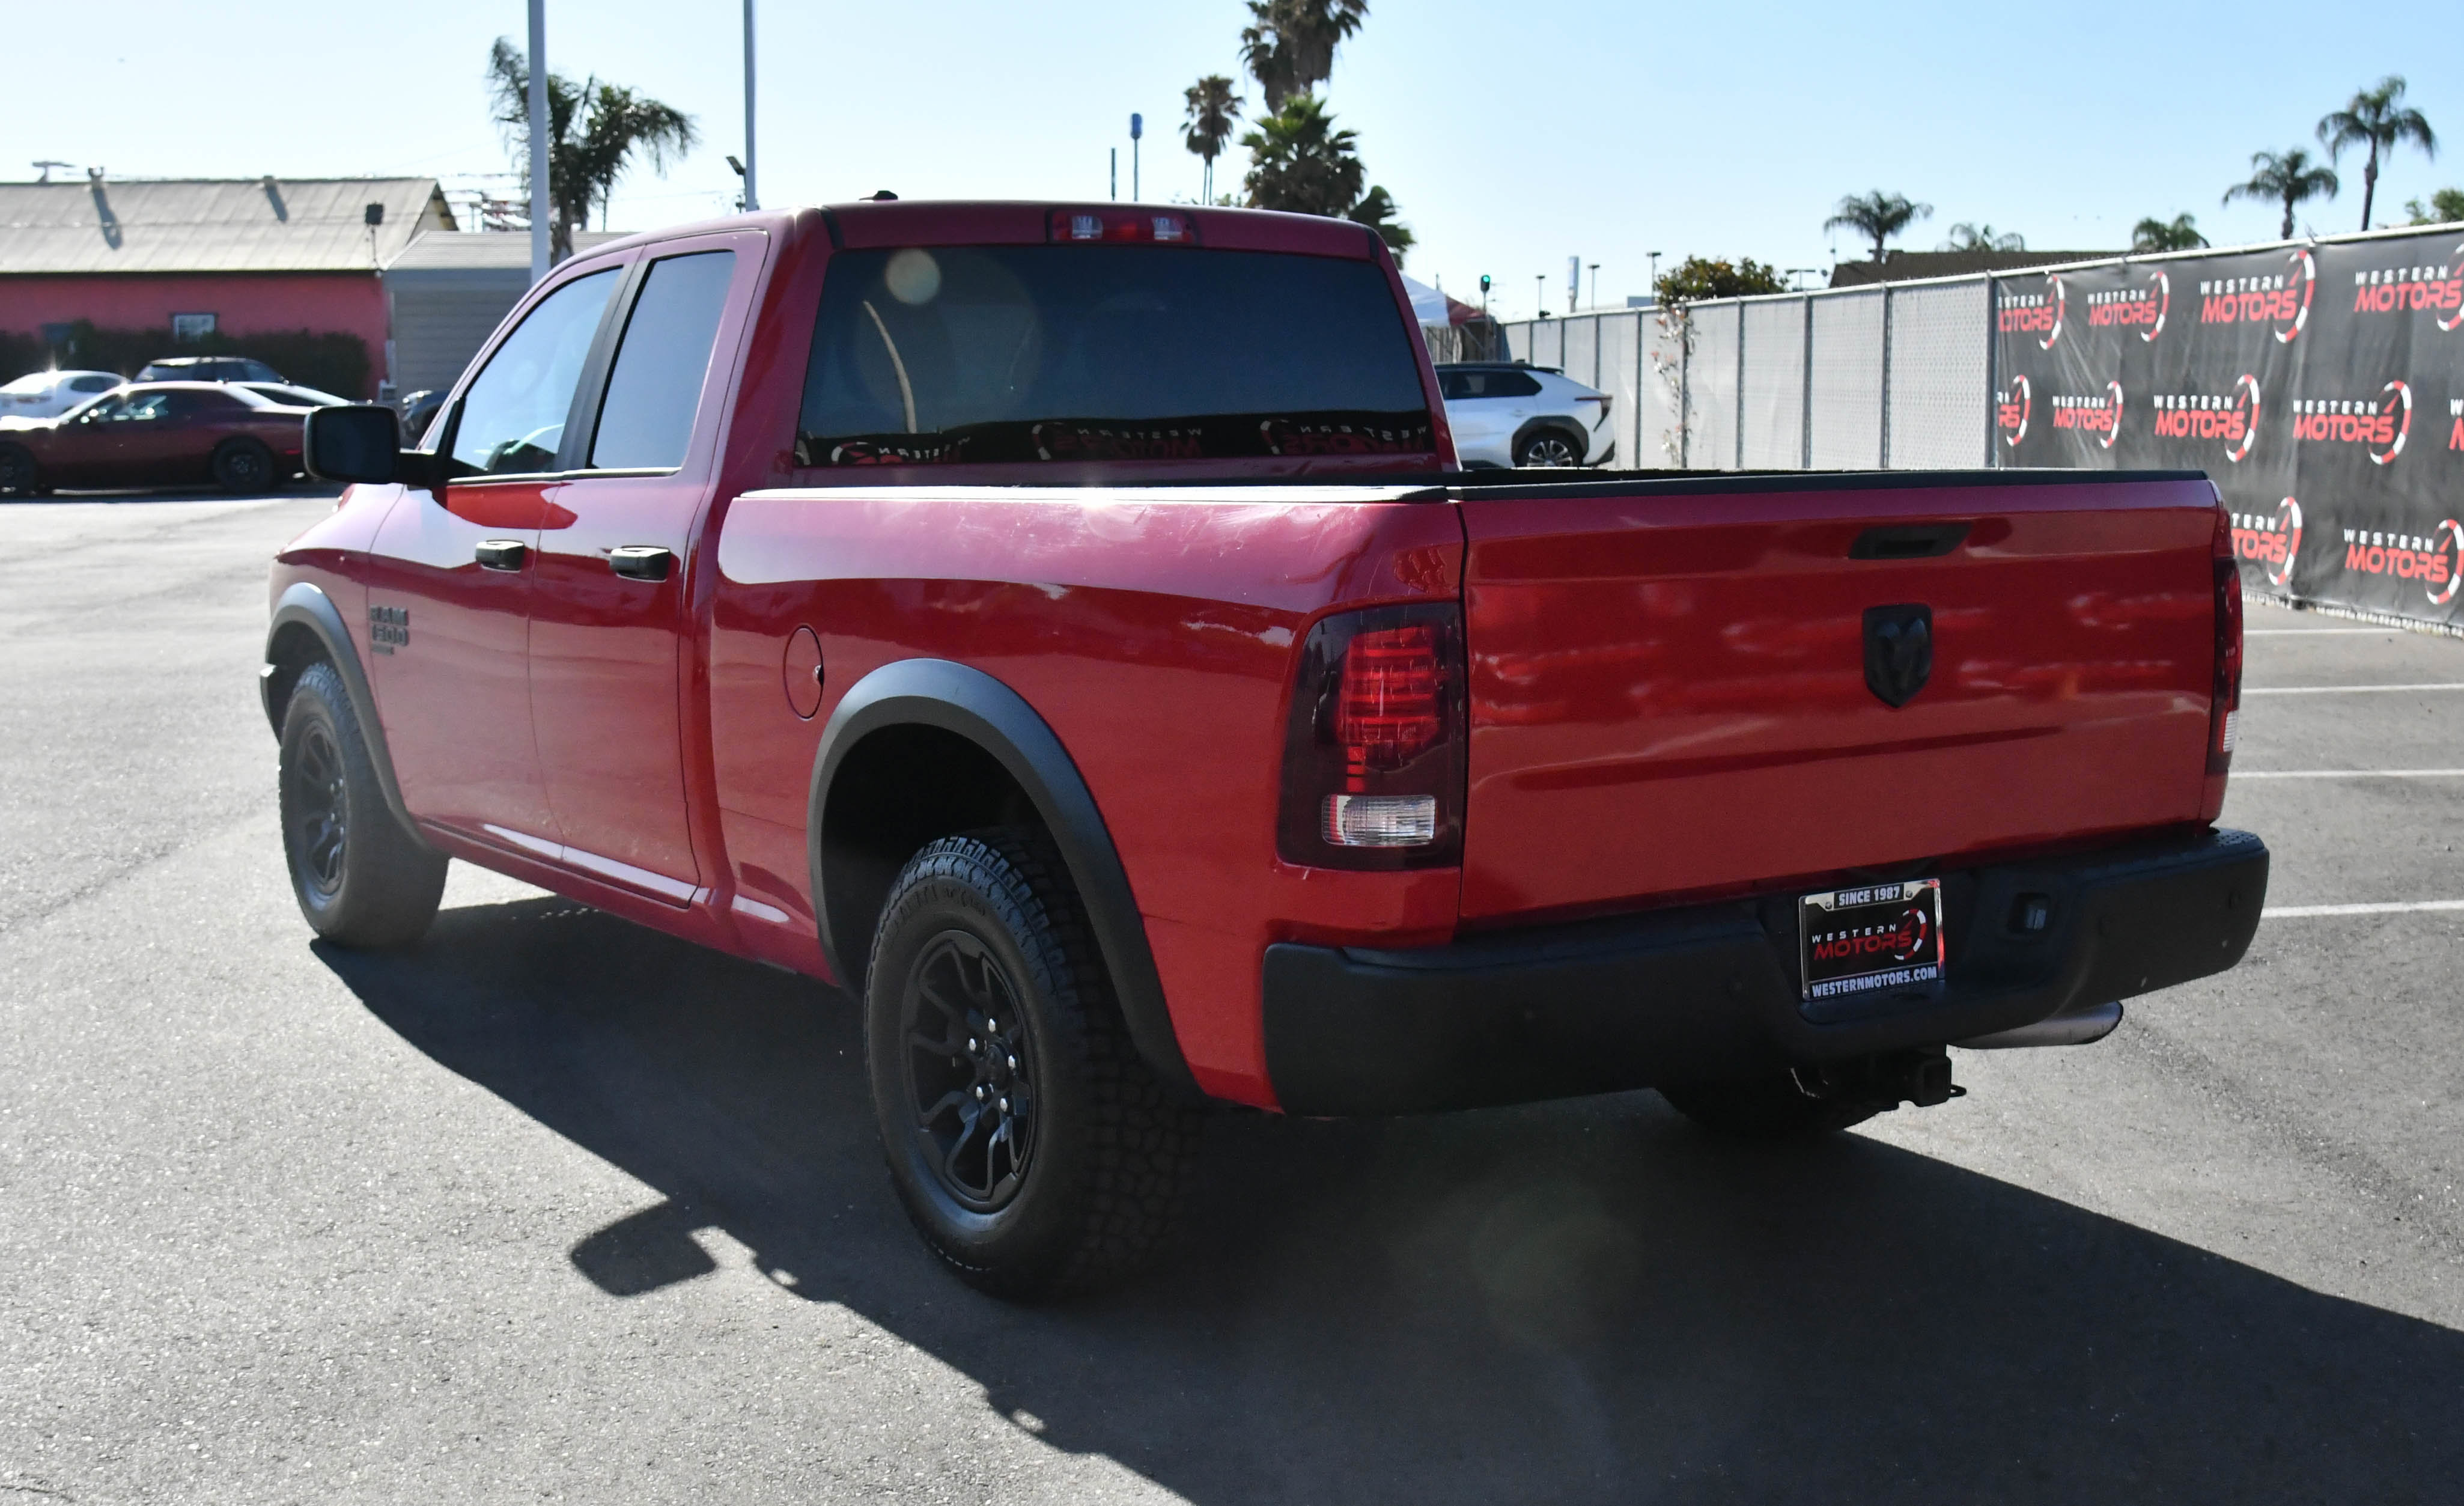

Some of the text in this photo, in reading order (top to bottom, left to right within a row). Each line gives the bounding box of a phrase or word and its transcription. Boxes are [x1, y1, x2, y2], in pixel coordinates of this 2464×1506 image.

[2200, 274, 2284, 294] WESTERN
[2355, 265, 2448, 285] WESTERN
[2087, 289, 2146, 305] WESTERN
[2201, 289, 2298, 323] MOTORS
[2353, 279, 2464, 312] MOTORS
[2088, 300, 2157, 326] MOTORS
[2052, 395, 2106, 409] WESTERN
[2153, 394, 2234, 412] WESTERN
[2293, 399, 2379, 415] WESTERN
[2053, 406, 2113, 431] MOTORS
[2154, 409, 2246, 441] MOTORS
[2292, 413, 2394, 444] MOTORS
[2343, 528, 2435, 553] WESTERN
[2345, 543, 2449, 584] MOTORS
[1838, 885, 1900, 906] SINCE 1987
[1811, 924, 1897, 944] WESTERN
[1814, 931, 1912, 961] MOTORS
[1811, 966, 1938, 998] WESTERNMOTORS.COM
